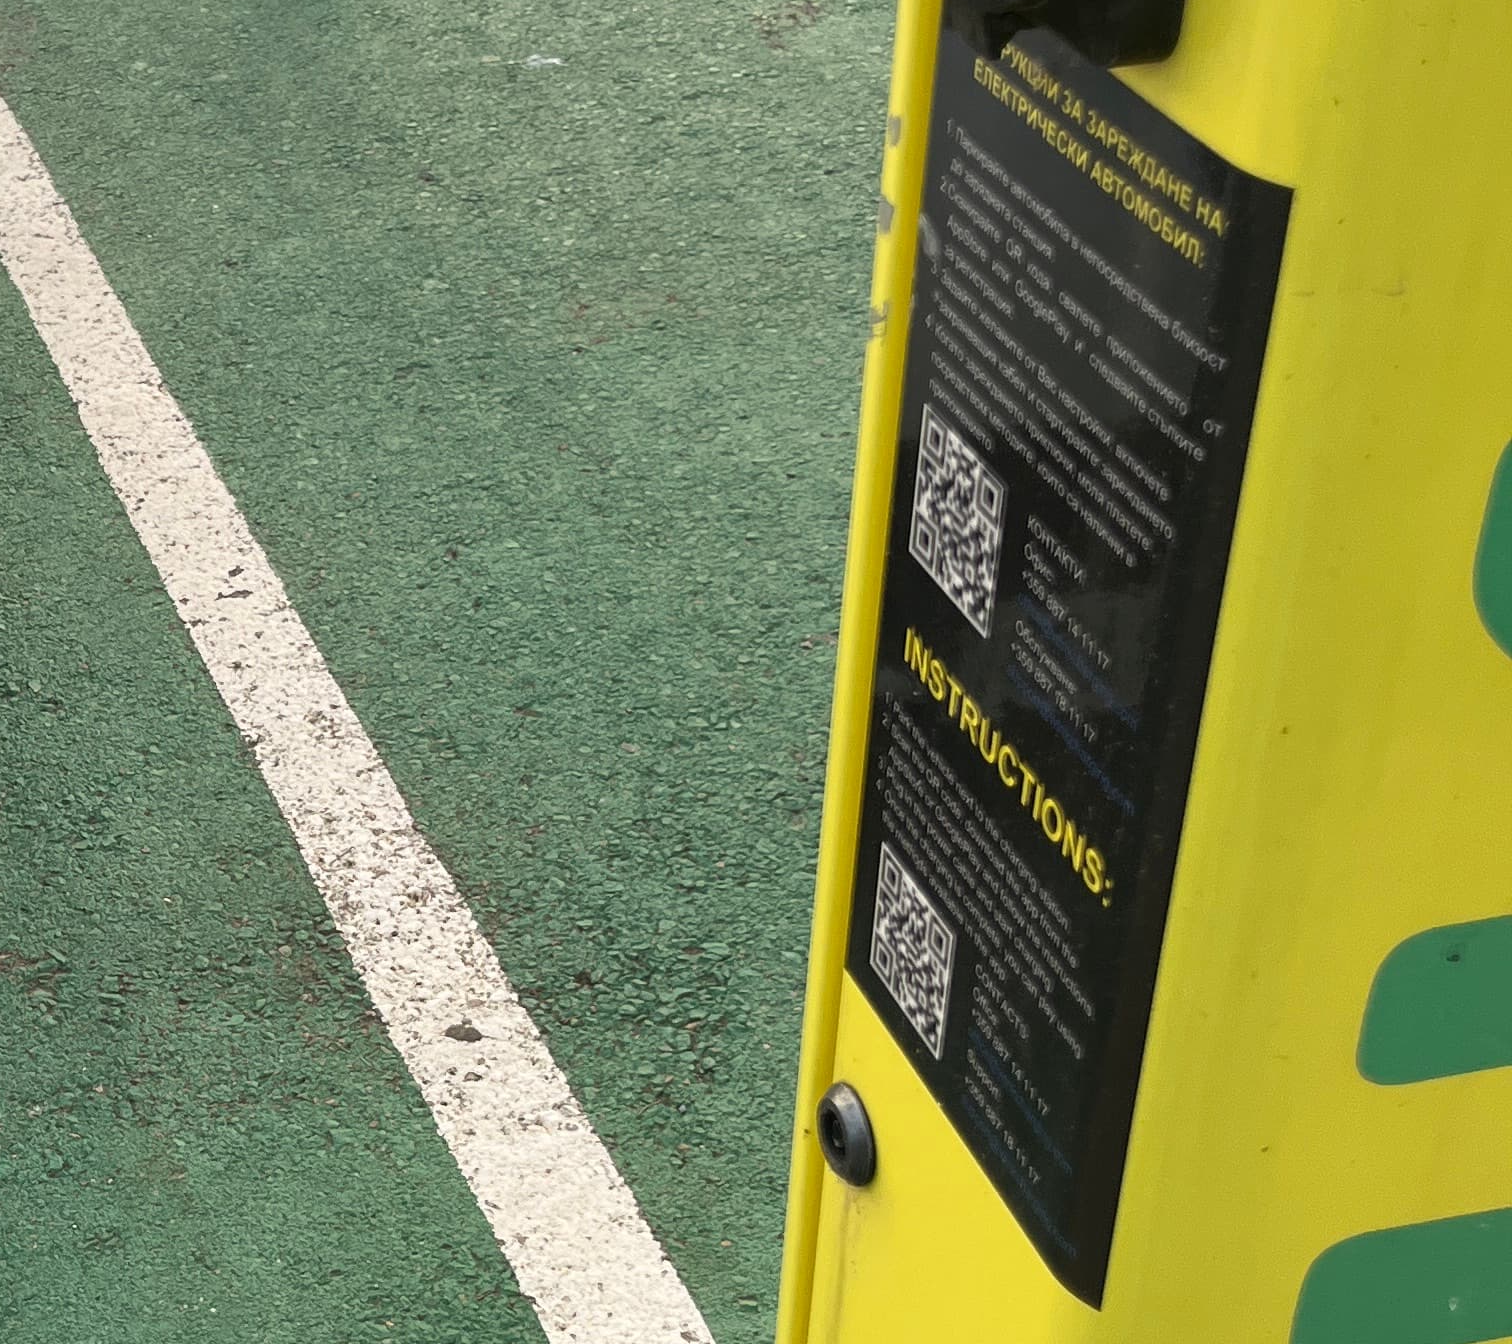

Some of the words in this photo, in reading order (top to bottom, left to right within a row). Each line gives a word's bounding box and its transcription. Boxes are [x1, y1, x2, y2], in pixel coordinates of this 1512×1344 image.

[962, 170, 1012, 219] зарядната
[973, 58, 1088, 169] ЕЛЕКТРИЧЕСКИ
[1089, 159, 1207, 267] АВТОМОБИЛ:
[999, 39, 1060, 102] РУКЦИИ
[1060, 88, 1084, 122] ЗА
[1085, 108, 1194, 212] ЗАРЕЖДАНЕ
[1193, 196, 1227, 236] НА
[946, 215, 987, 261] AppStore
[990, 260, 1009, 281] или
[1013, 279, 1070, 341] GooglePlay
[1087, 353, 1147, 412] следвайте
[1146, 406, 1205, 461] стъпките
[955, 128, 1010, 186] Паркирайте
[1009, 179, 1070, 240] автомобила
[1078, 243, 1169, 328] непосредствена
[1170, 320, 1226, 371] близост
[1004, 238, 1023, 262] QR
[1057, 292, 1101, 336] свалете
[1104, 335, 1188, 415] приложението
[1201, 416, 1224, 436] от
[930, 351, 988, 413] посредством
[1036, 462, 1065, 496] които
[1065, 493, 1079, 509] са
[1079, 508, 1124, 555] налични
[934, 324, 964, 360] Когато
[964, 359, 1024, 422] зареждането
[1076, 473, 1105, 503] моля
[939, 268, 978, 313] Задайте
[978, 310, 1023, 358] желаните
[1023, 357, 1036, 371] от
[1036, 366, 1058, 391] Вас
[1113, 444, 1170, 501] включете
[997, 357, 1026, 392] кабел
[1034, 398, 1099, 465] стартирайте
[1009, 639, 1033, 672] +359
[1033, 666, 1052, 693] 887
[1053, 690, 1067, 710] 18
[1068, 706, 1080, 726] 11
[1082, 723, 1096, 744] 17
[1020, 566, 1045, 599] +359
[1045, 593, 1065, 621] 887
[1066, 616, 1079, 636] 14
[1080, 631, 1094, 653] 11
[1096, 649, 1111, 671] 17
[885, 765, 904, 796] Plug
[903, 790, 912, 805] in
[912, 801, 926, 823] the
[926, 822, 952, 857] power
[952, 853, 975, 888] cable
[975, 884, 992, 910] and
[992, 907, 1013, 936] start
[887, 745, 924, 795] AppStore
[923, 793, 935, 809] or
[934, 805, 981, 873] GooglePlay
[981, 866, 999, 892] and
[999, 888, 1025, 926] follow
[1025, 924, 1041, 947] the
[890, 724, 911, 754] Scan
[910, 750, 925, 772] the
[924, 766, 940, 791] QR
[963, 818, 1005, 873] download
[1005, 869, 1021, 893] the
[1020, 891, 1039, 920] app
[1038, 913, 1060, 946] from
[1061, 942, 1077, 966] the
[892, 701, 912, 730] Park
[911, 725, 926, 747] the
[926, 743, 955, 784] vehicle
[954, 780, 974, 808] next
[974, 805, 984, 820] to
[984, 816, 999, 839] the
[999, 835, 1037, 890] charging
[903, 626, 1114, 908] INSTRUCTIONS:
[881, 810, 894, 831] the
[894, 827, 928, 876] methods
[964, 921, 973, 935] in
[973, 933, 988, 955] the
[883, 788, 905, 821] Once
[905, 817, 919, 838] the
[918, 834, 953, 887] charging
[953, 881, 962, 895] is
[1002, 949, 1020, 976] you
[1020, 971, 1037, 997] can
[1037, 995, 1056, 1025] pay
[1055, 1018, 1081, 1058] using
[970, 1006, 992, 1038] +359
[992, 1035, 1009, 1062] 887
[1010, 1061, 1022, 1080] 14
[1023, 1079, 1034, 1097] 11
[1036, 1097, 1049, 1118] 17
[1002, 1130, 1014, 1149] 18
[1015, 1147, 1026, 1166] 11
[1028, 1166, 1040, 1186] 17
